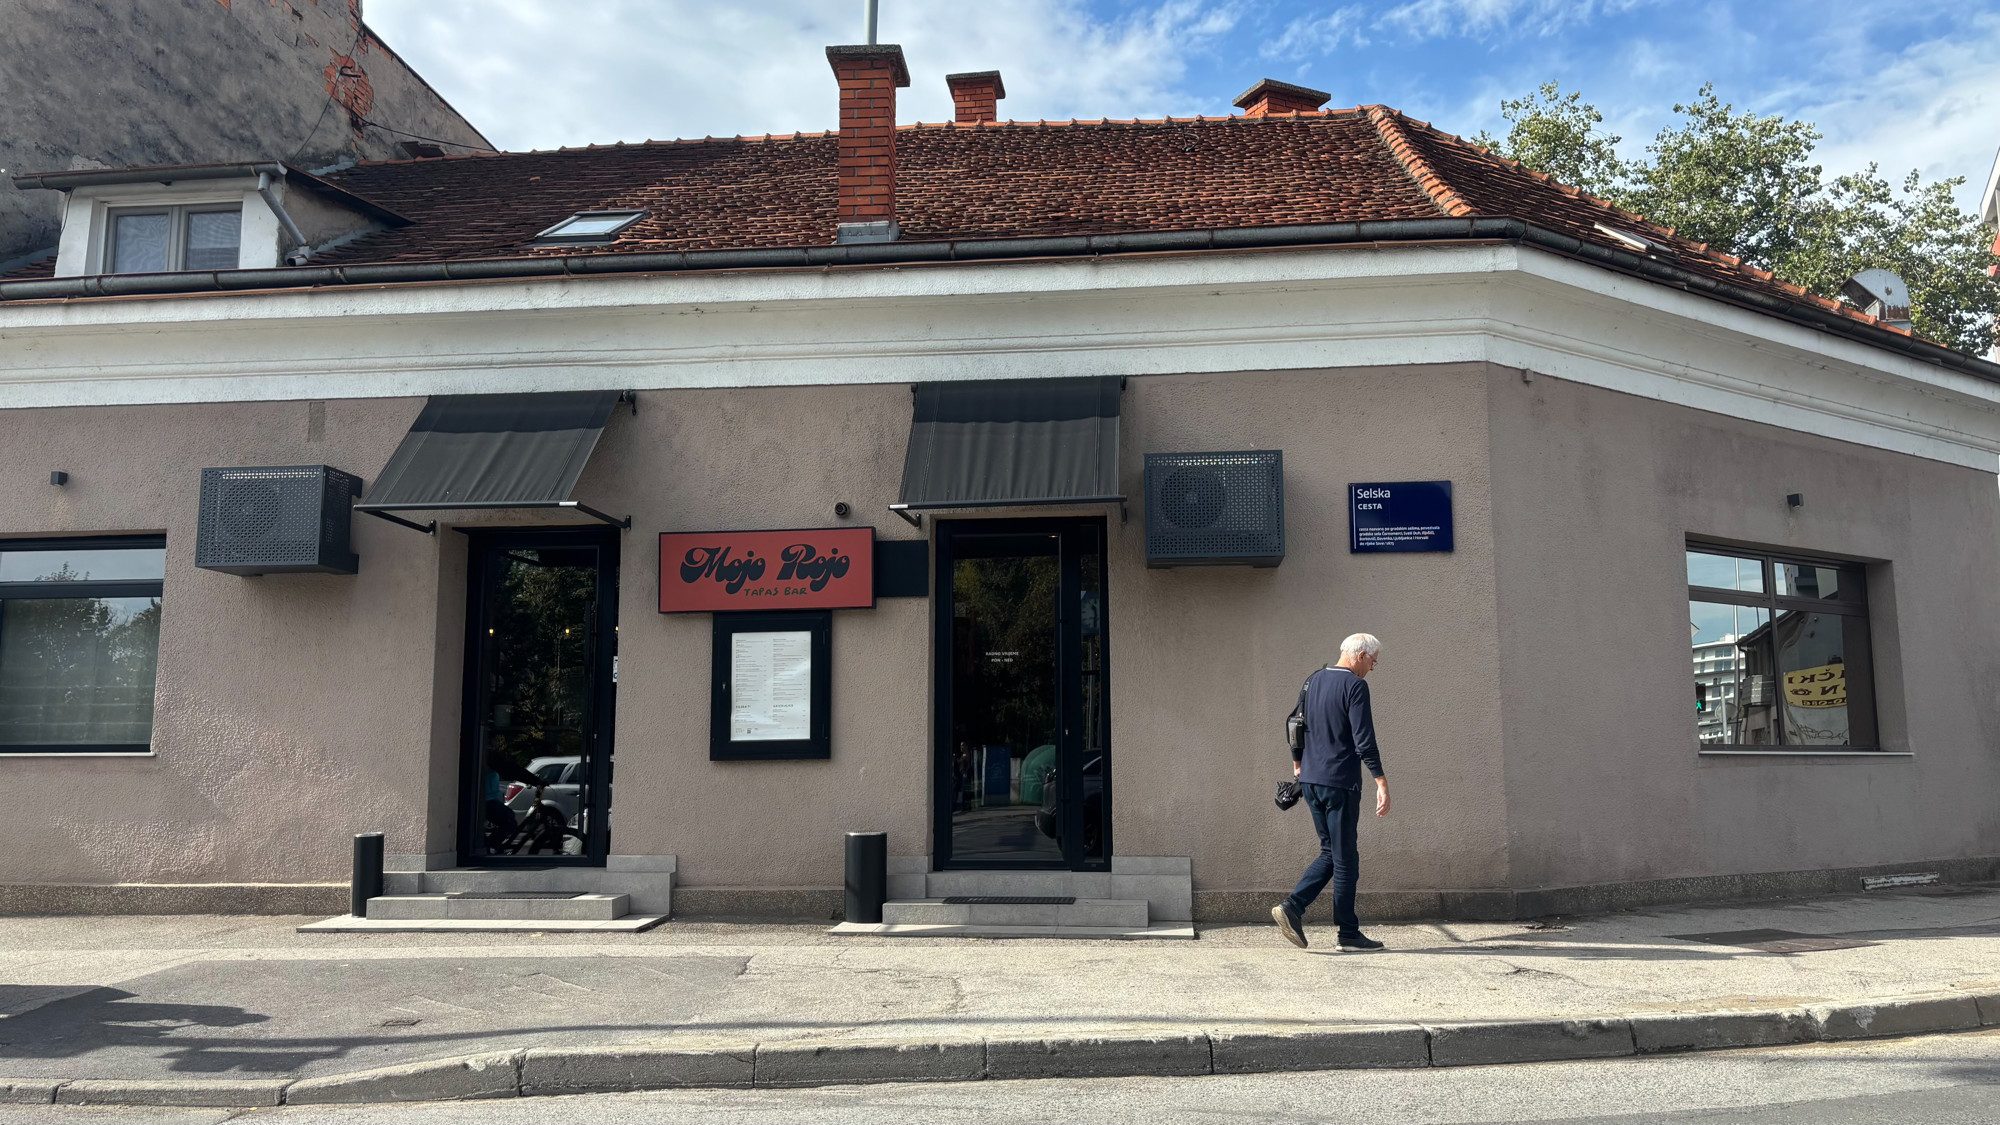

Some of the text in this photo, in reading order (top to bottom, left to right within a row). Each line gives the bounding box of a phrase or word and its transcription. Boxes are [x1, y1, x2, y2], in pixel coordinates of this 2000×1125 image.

[1357, 487, 1391, 499] Selska
[680, 543, 850, 595] Mojo Rojo
[744, 586, 808, 597] TAPAS BAR
